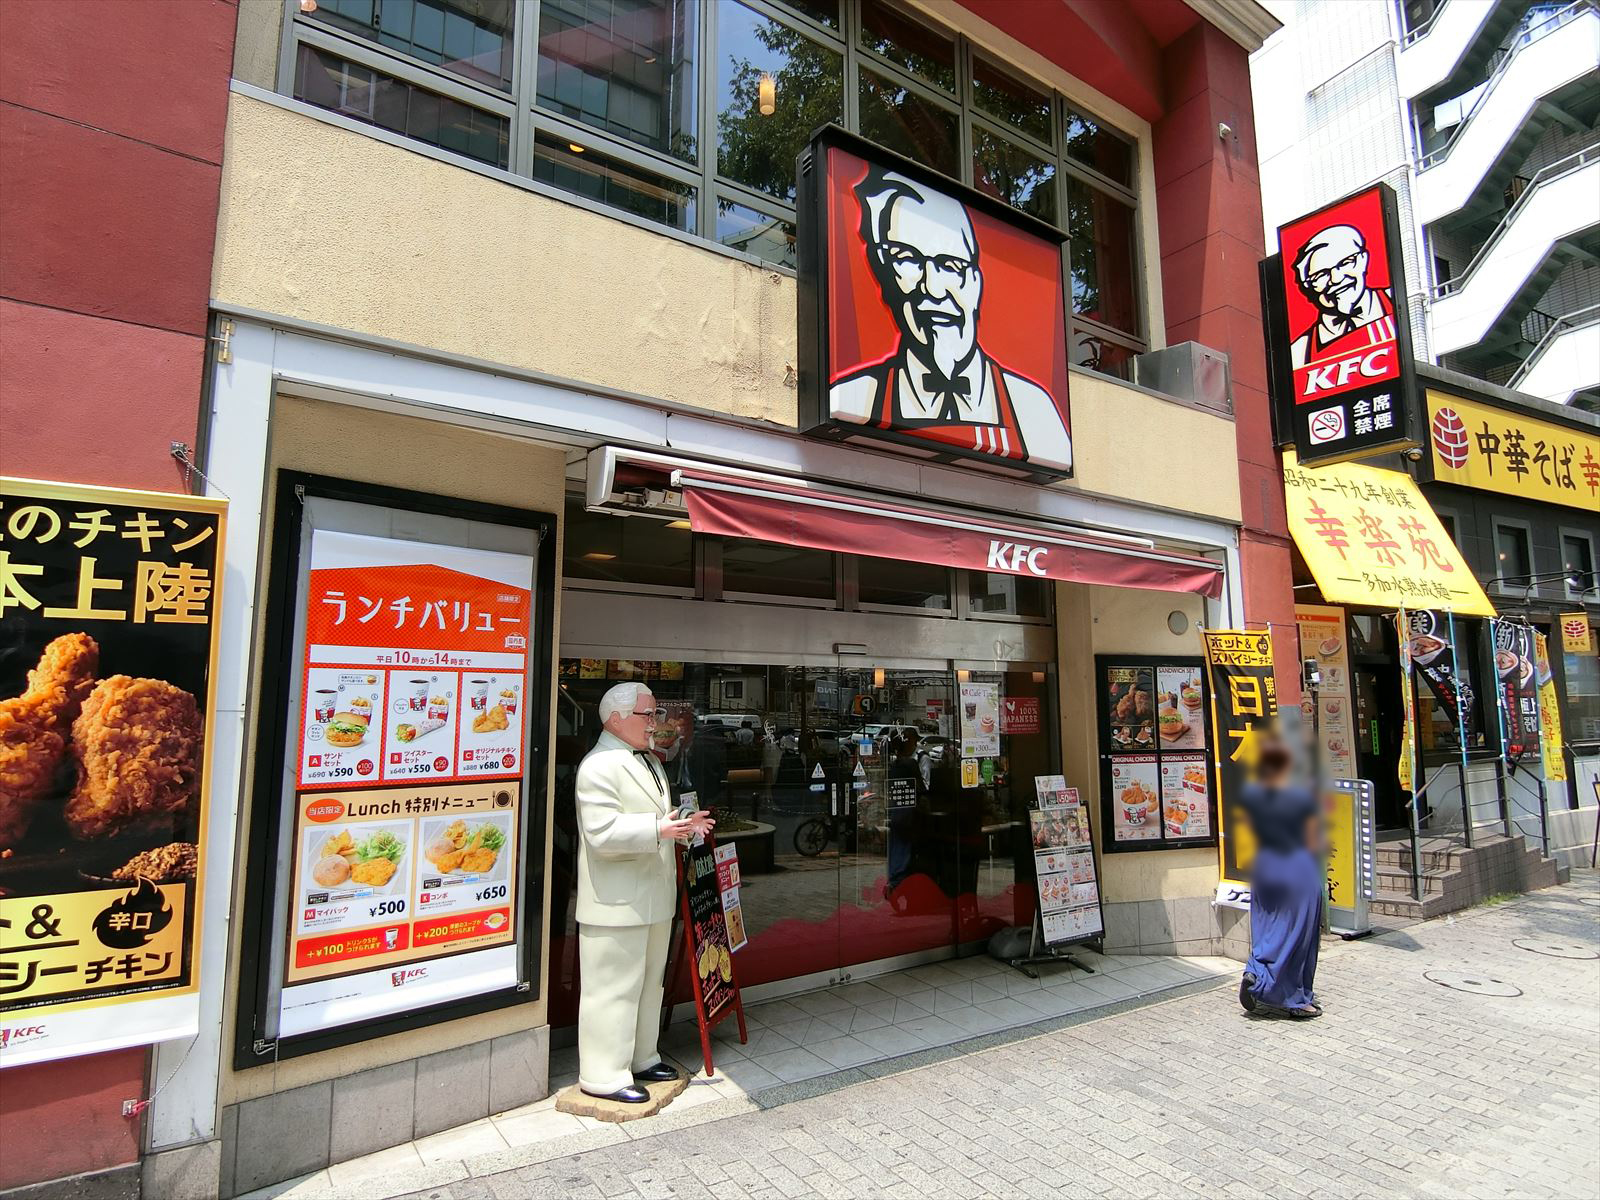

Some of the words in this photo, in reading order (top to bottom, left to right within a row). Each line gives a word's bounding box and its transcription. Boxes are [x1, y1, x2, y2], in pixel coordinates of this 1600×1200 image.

[1303, 348, 1388, 397] KFC
[1353, 394, 1391, 419] 全席
[1354, 414, 1393, 436] 禁煙
[0, 501, 213, 553] のチキン
[1304, 496, 1454, 573] 幸楽苑
[987, 540, 1048, 576] KFC
[322, 590, 521, 632] ランチバリュー
[329, 767, 353, 778] ¥590
[408, 764, 431, 774] ¥550
[479, 761, 499, 770] ¥680
[347, 800, 400, 817] Lunch
[405, 797, 489, 813] 特別メニュー
[475, 885, 506, 901] ¥650
[369, 900, 405, 917] ¥500
[108, 911, 153, 931] 辛口
[407, 967, 427, 978] KFC
[14, 1025, 46, 1038] KFC
